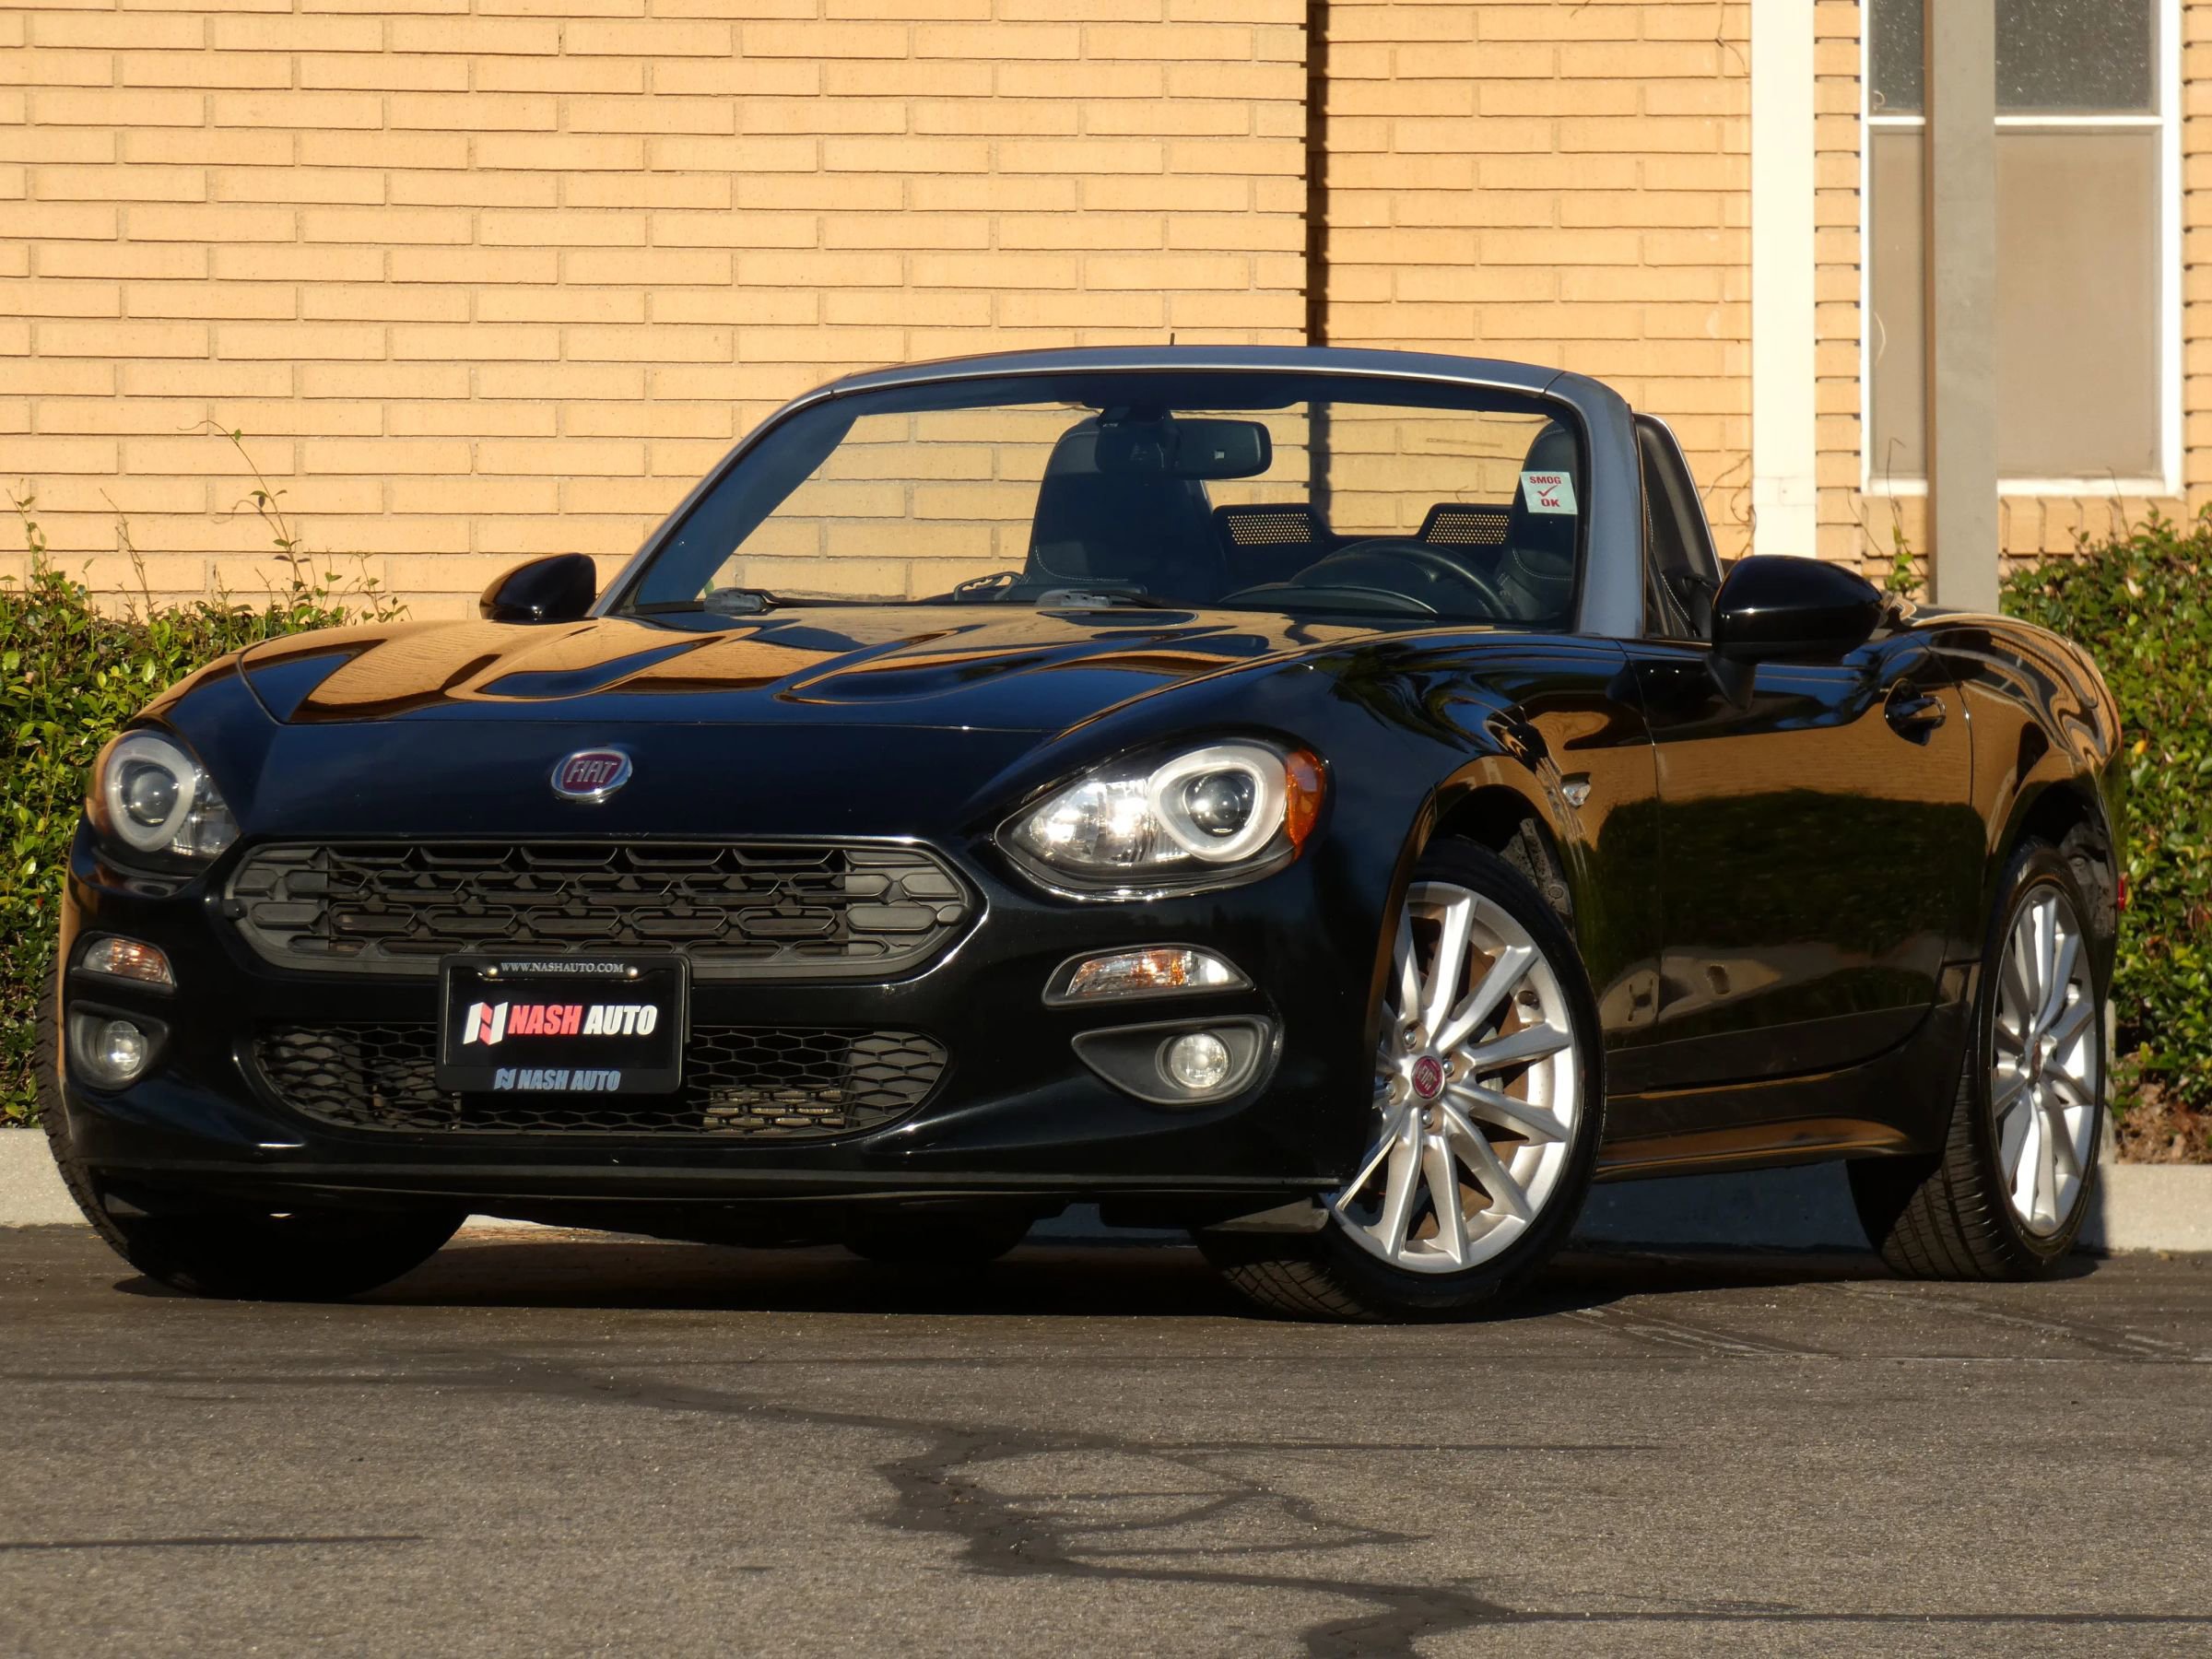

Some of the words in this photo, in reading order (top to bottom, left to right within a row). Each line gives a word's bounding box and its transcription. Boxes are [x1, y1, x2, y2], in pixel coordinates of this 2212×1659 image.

[1529, 476, 1561, 485] SMOG
[1541, 499, 1560, 508] OK
[566, 760, 618, 783] FIAT
[500, 962, 624, 974] WWW.NASHAUTO.COM
[508, 1005, 582, 1035] NASH
[582, 1005, 658, 1035] AUTO
[517, 1069, 569, 1090] NASH
[571, 1070, 621, 1091] AUTO
